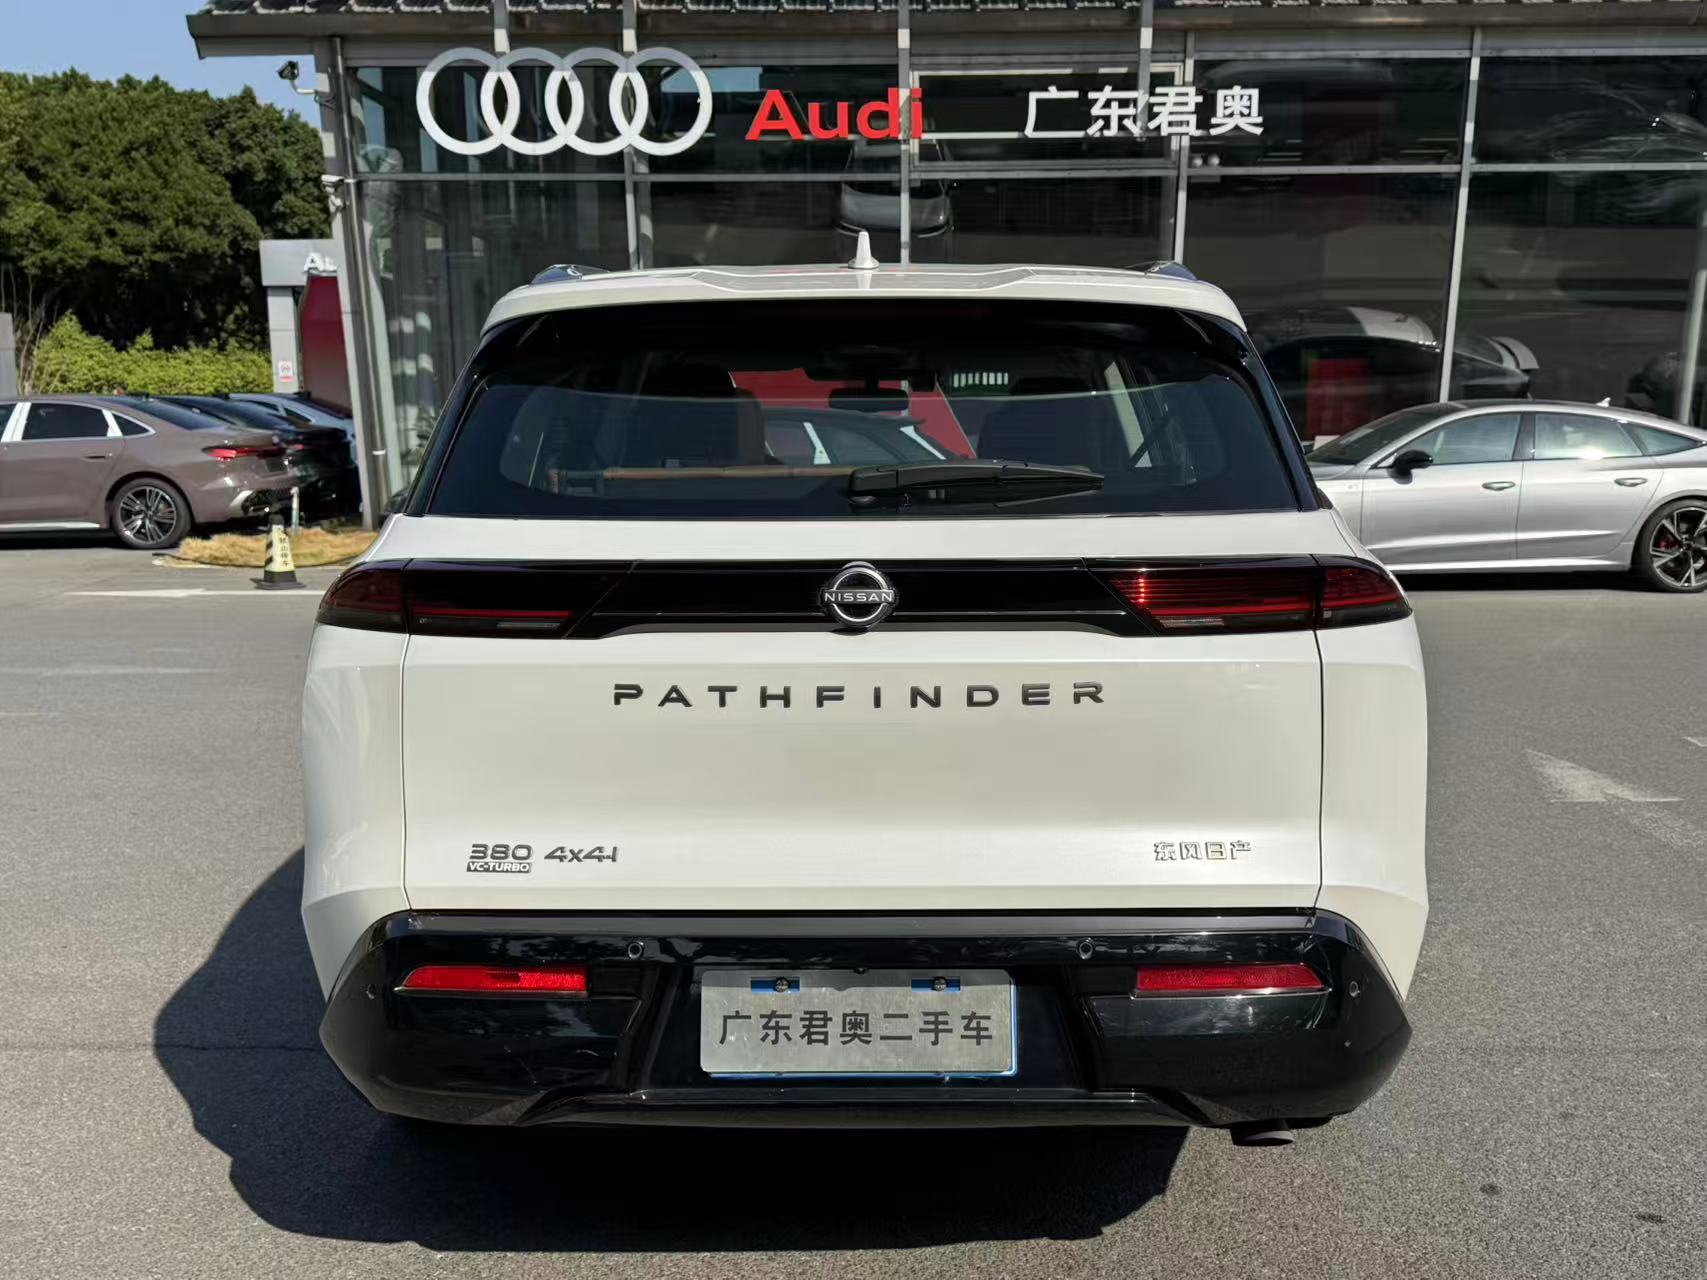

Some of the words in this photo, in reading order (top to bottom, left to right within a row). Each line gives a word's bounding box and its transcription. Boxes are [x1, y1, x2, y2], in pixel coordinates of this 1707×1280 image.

[745, 87, 922, 140] Audi
[1024, 85, 1264, 137] 广东君奥
[824, 592, 892, 602] NISSAN
[613, 681, 1105, 708] PATHFINDER
[469, 843, 533, 861] 380
[1153, 840, 1252, 861] 东风日产
[468, 861, 531, 873] VC-TURBO
[719, 1010, 993, 1046] 广东君奥二手车
